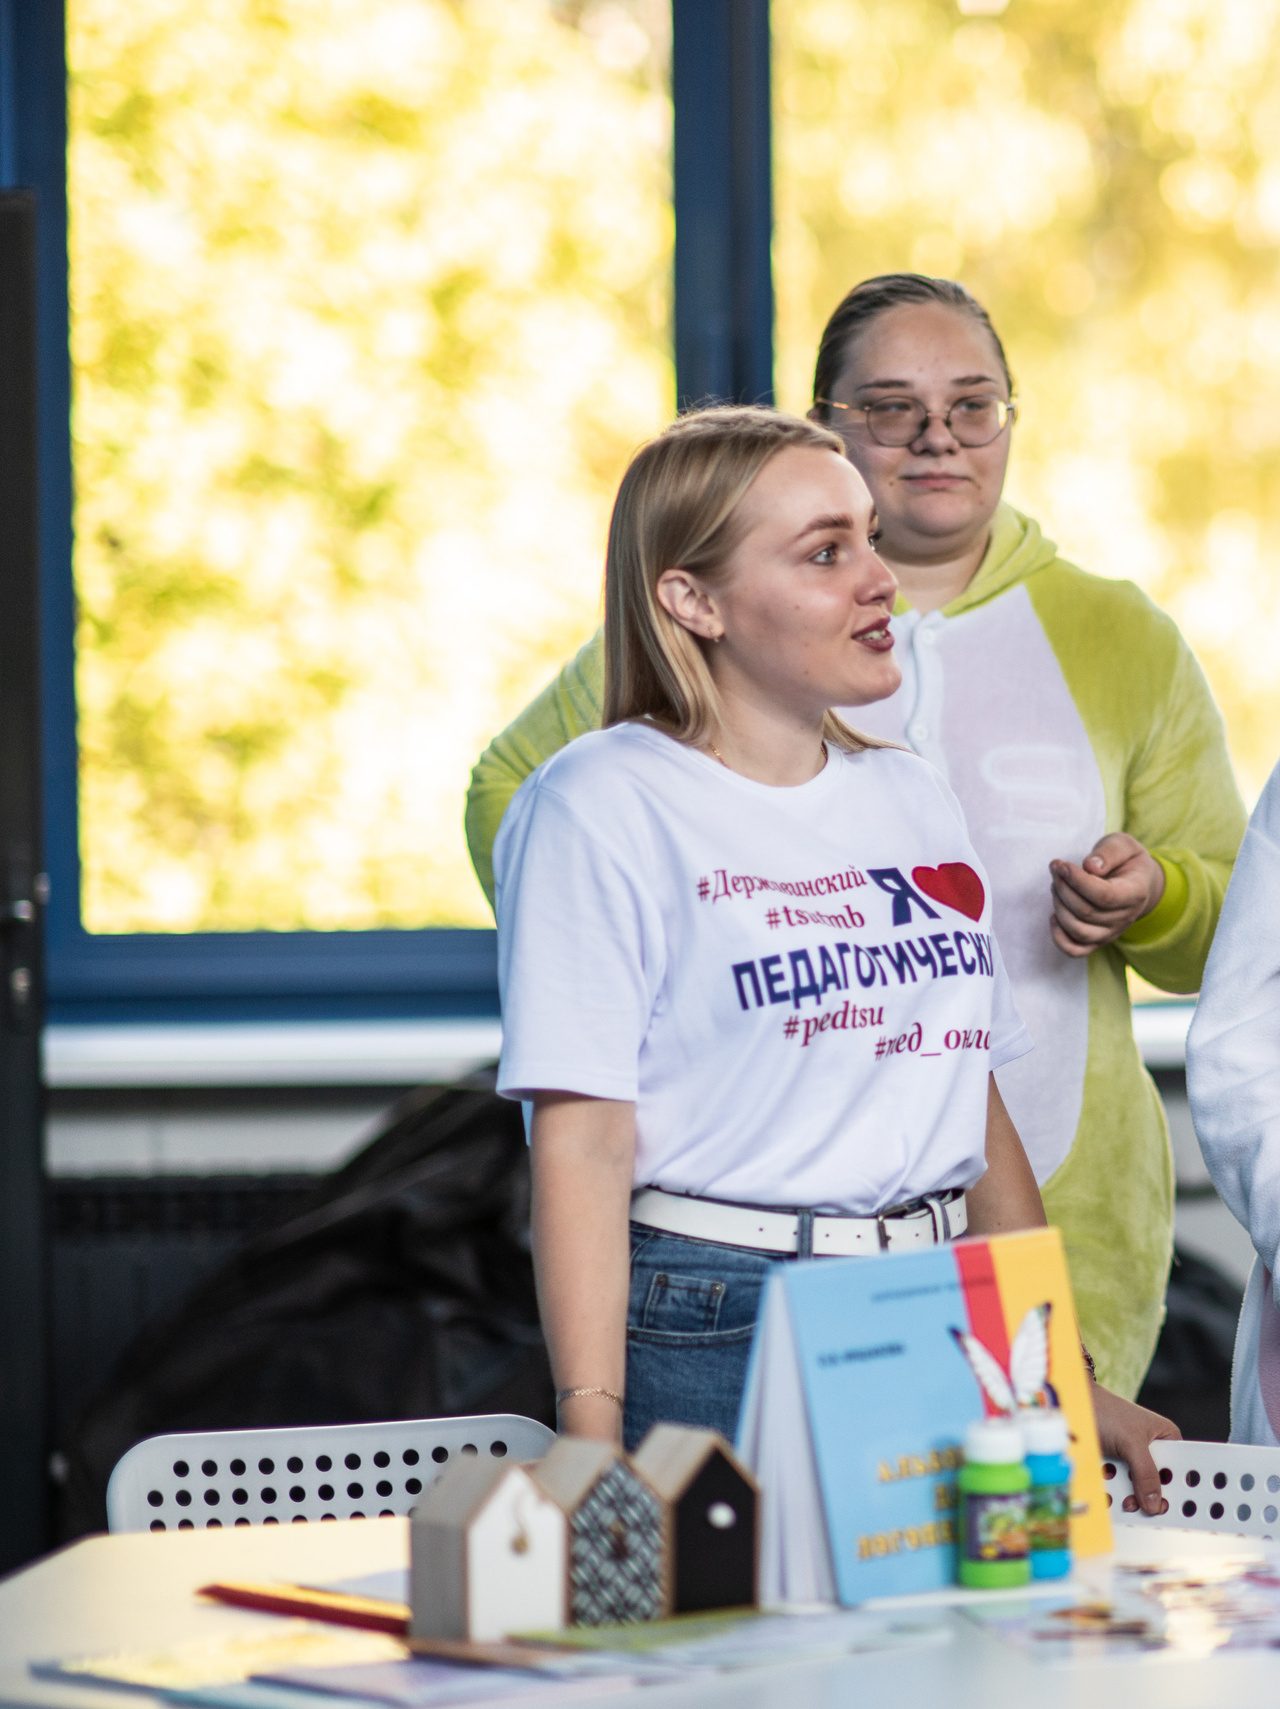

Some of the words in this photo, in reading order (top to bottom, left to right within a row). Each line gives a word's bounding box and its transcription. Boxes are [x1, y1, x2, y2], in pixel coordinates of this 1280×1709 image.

[765, 904, 865, 930] #tsutmb
[866, 867, 942, 927] Я
[783, 1000, 884, 1047] #pedtsu
